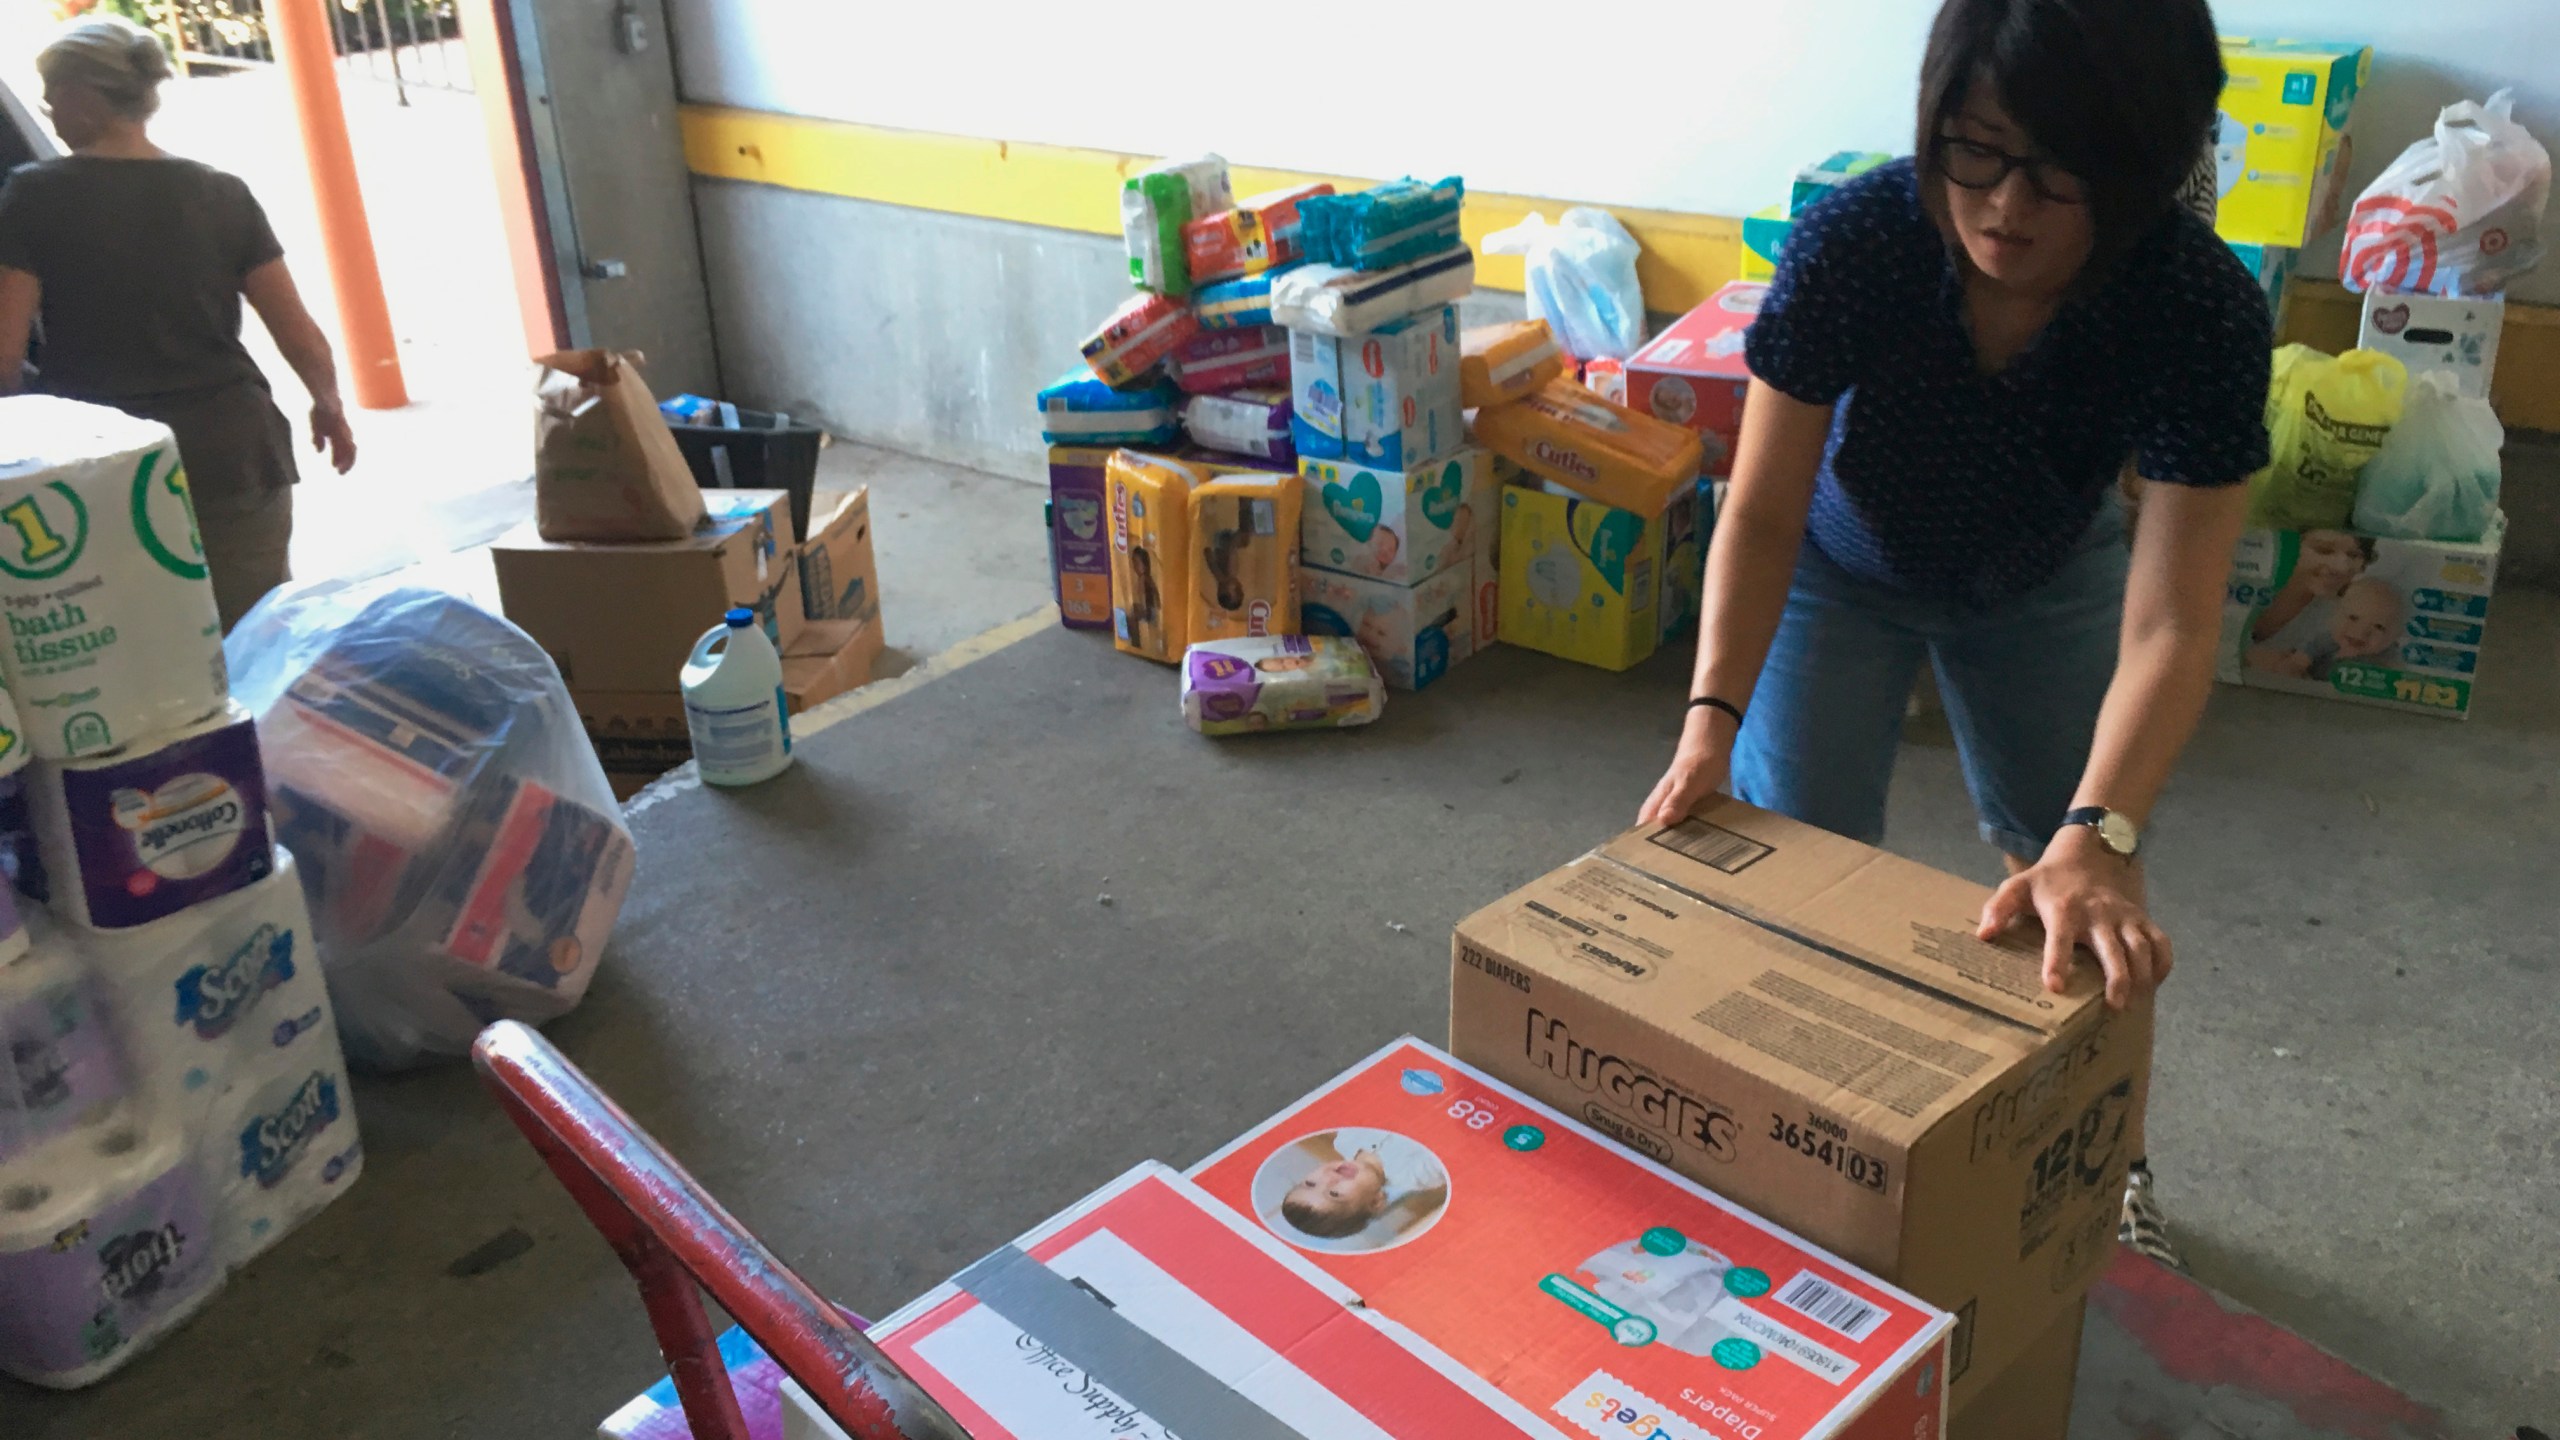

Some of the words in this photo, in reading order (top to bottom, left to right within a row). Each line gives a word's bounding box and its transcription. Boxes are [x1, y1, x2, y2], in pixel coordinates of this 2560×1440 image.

[1535, 441, 1597, 480] Cuties
[1112, 482, 1128, 554] Cuties
[5, 603, 86, 636] bath
[14, 625, 117, 664] tissue
[2337, 667, 2364, 686] 12
[1461, 945, 1483, 970] 222
[1485, 956, 1532, 994] DIAPERS
[1525, 1006, 1738, 1164] HUGGIES
[1447, 1099, 1495, 1130] 88
[1590, 1108, 1624, 1134] Snug
[1638, 1129, 1664, 1157] Dry
[1807, 1111, 1849, 1142] 36000
[1679, 1387, 1763, 1440] Diapers
[1718, 1385, 1744, 1404] PACK
[1743, 1400, 1777, 1423] SUPER
